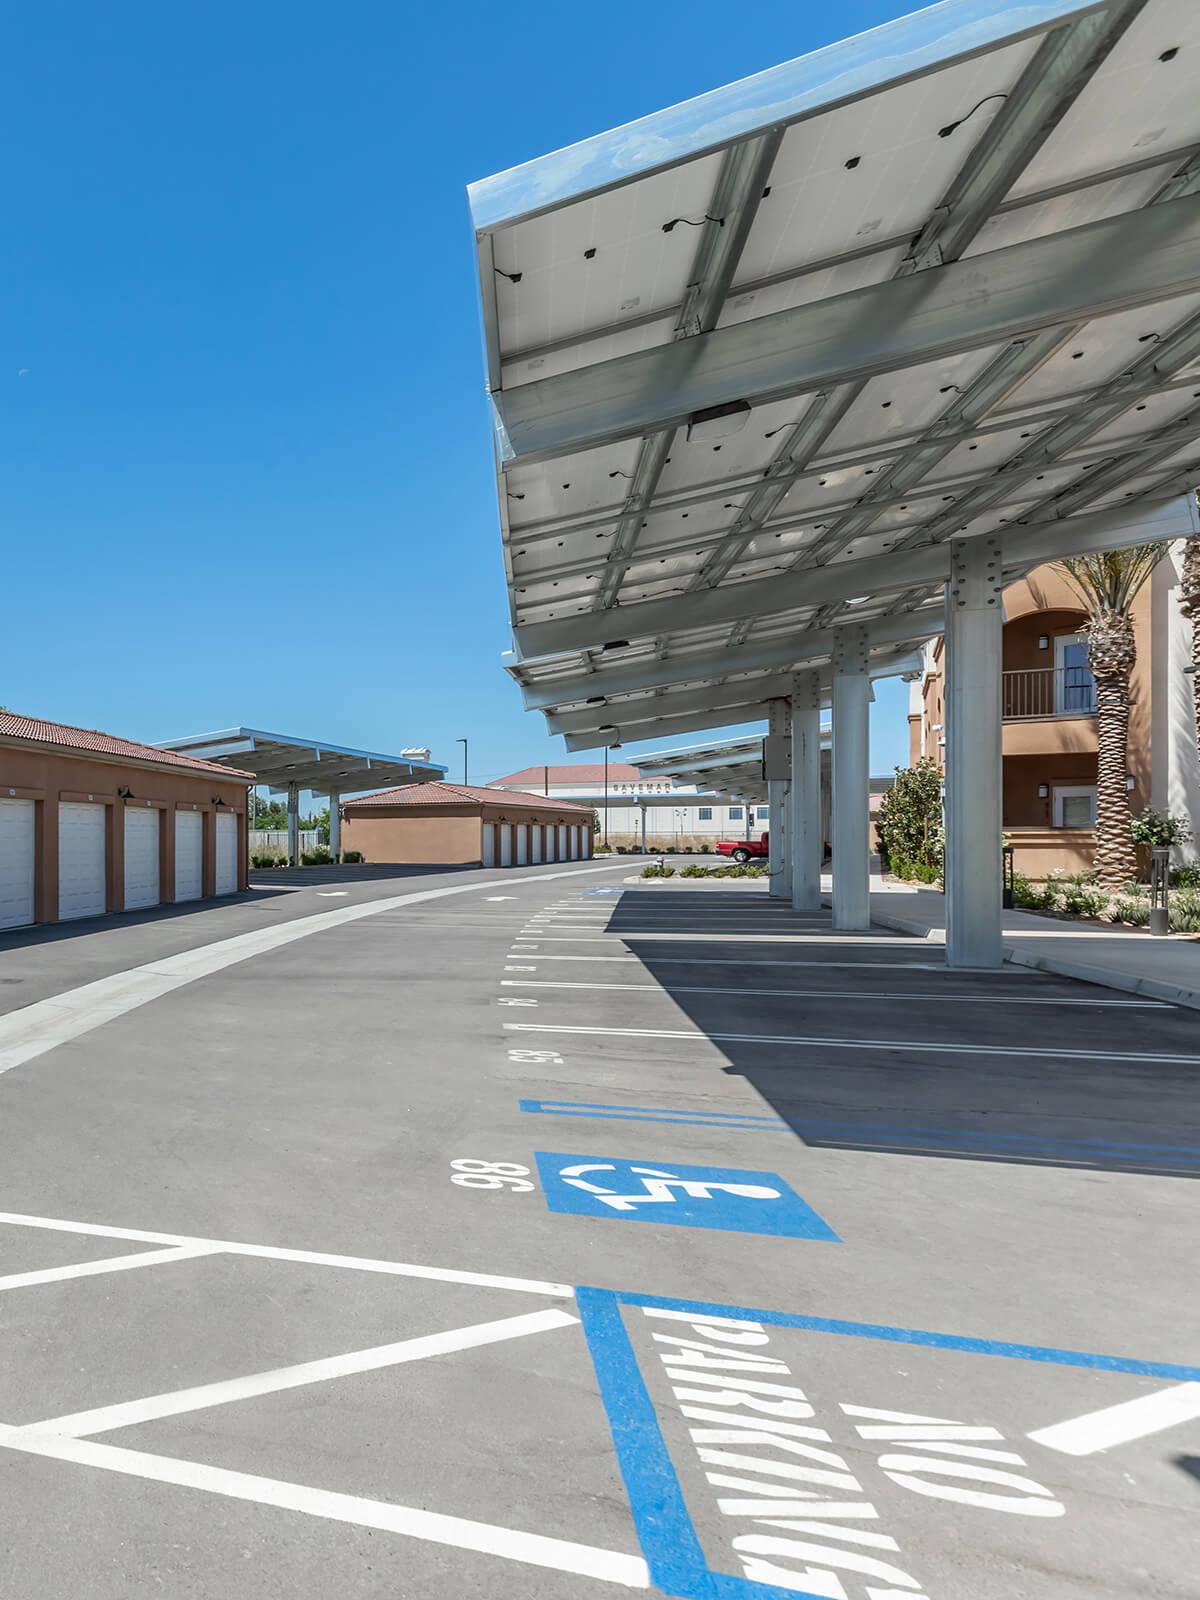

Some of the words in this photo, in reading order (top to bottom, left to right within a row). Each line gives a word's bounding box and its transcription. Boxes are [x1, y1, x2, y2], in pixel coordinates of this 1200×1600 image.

[507, 1049, 565, 1065] 85
[450, 1158, 536, 1193] 86
[641, 1306, 931, 1600] PARKING
[838, 1402, 1067, 1518] NO
